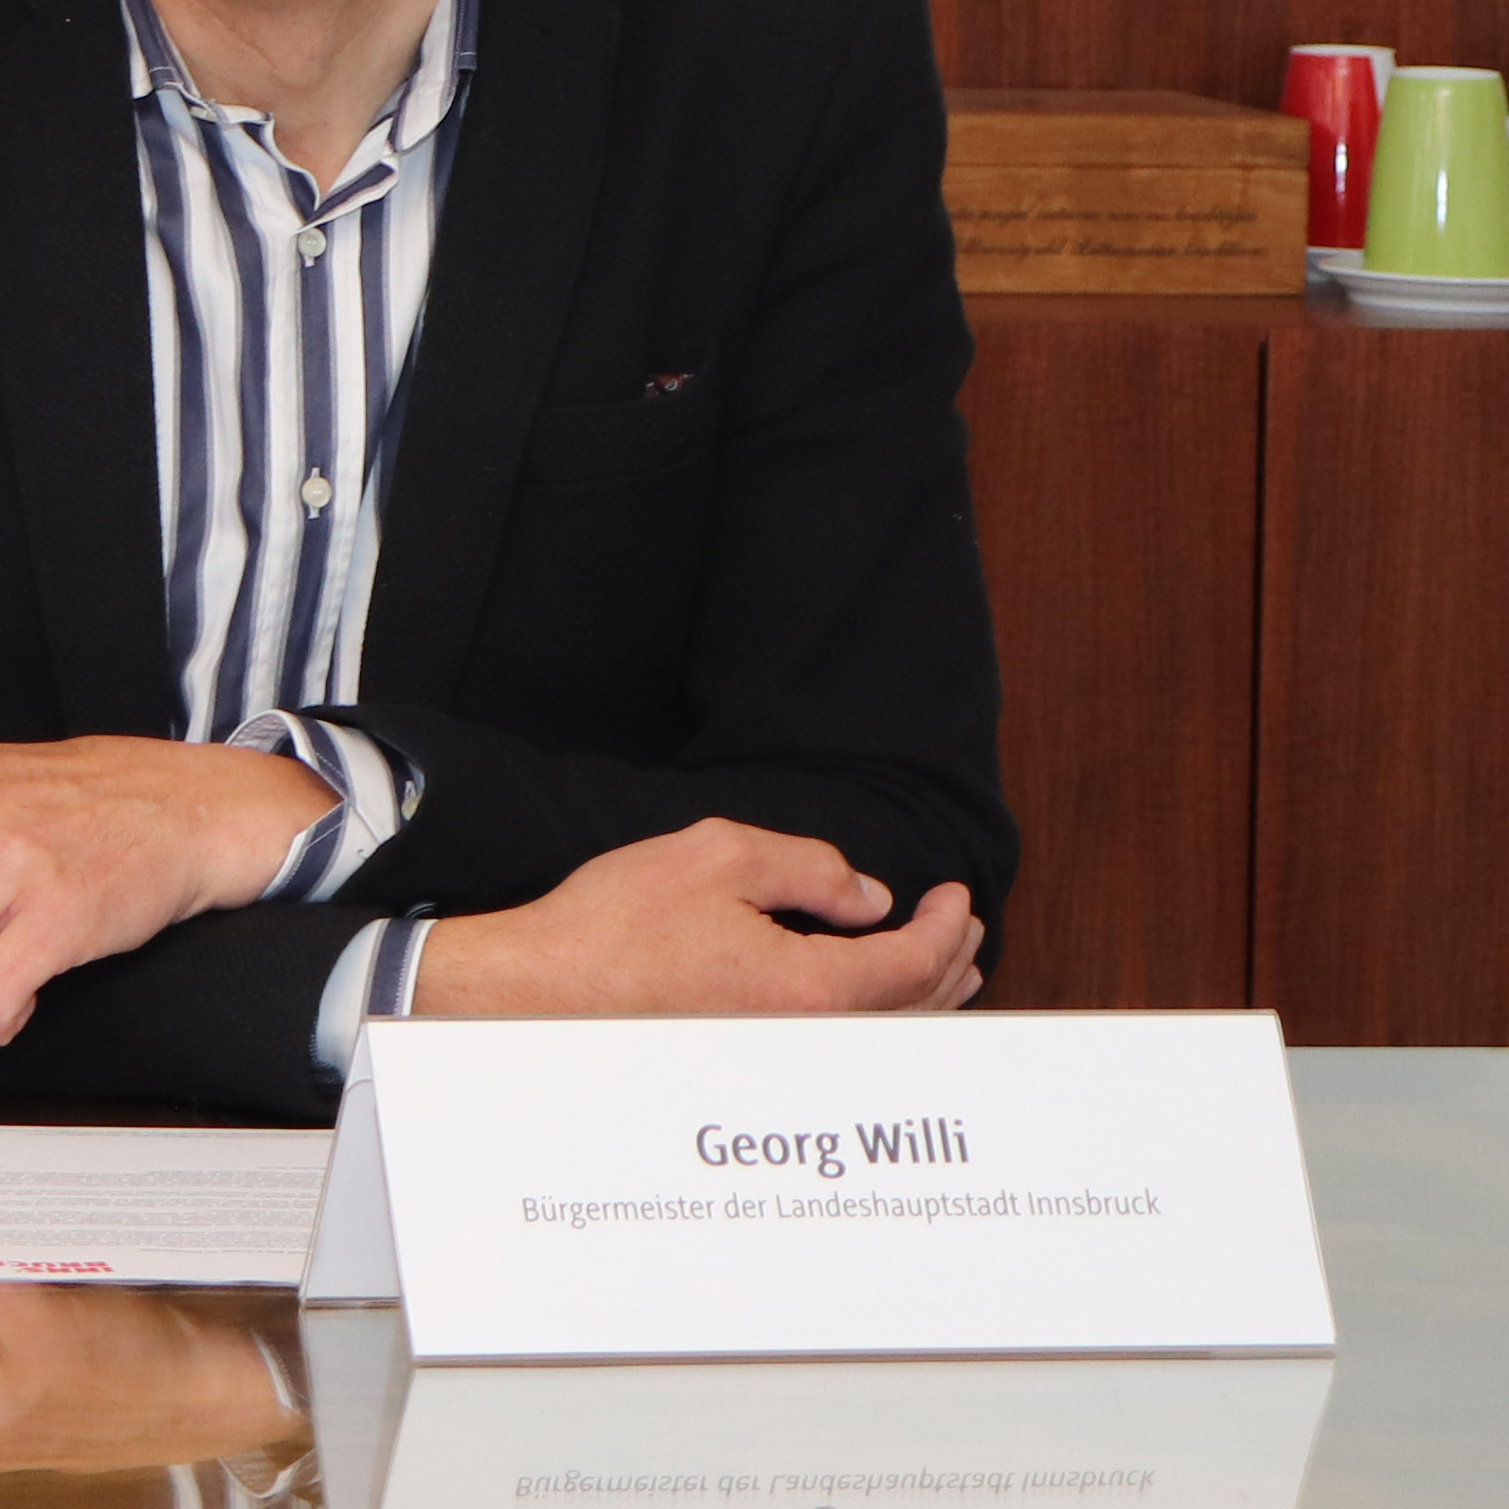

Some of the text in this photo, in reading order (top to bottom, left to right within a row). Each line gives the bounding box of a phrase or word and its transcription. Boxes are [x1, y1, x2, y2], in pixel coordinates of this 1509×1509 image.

[696, 1117, 969, 1179] Georg Willi
[522, 1188, 1161, 1229] Bürgermeister der Landeshauptstadt Innsbruck
